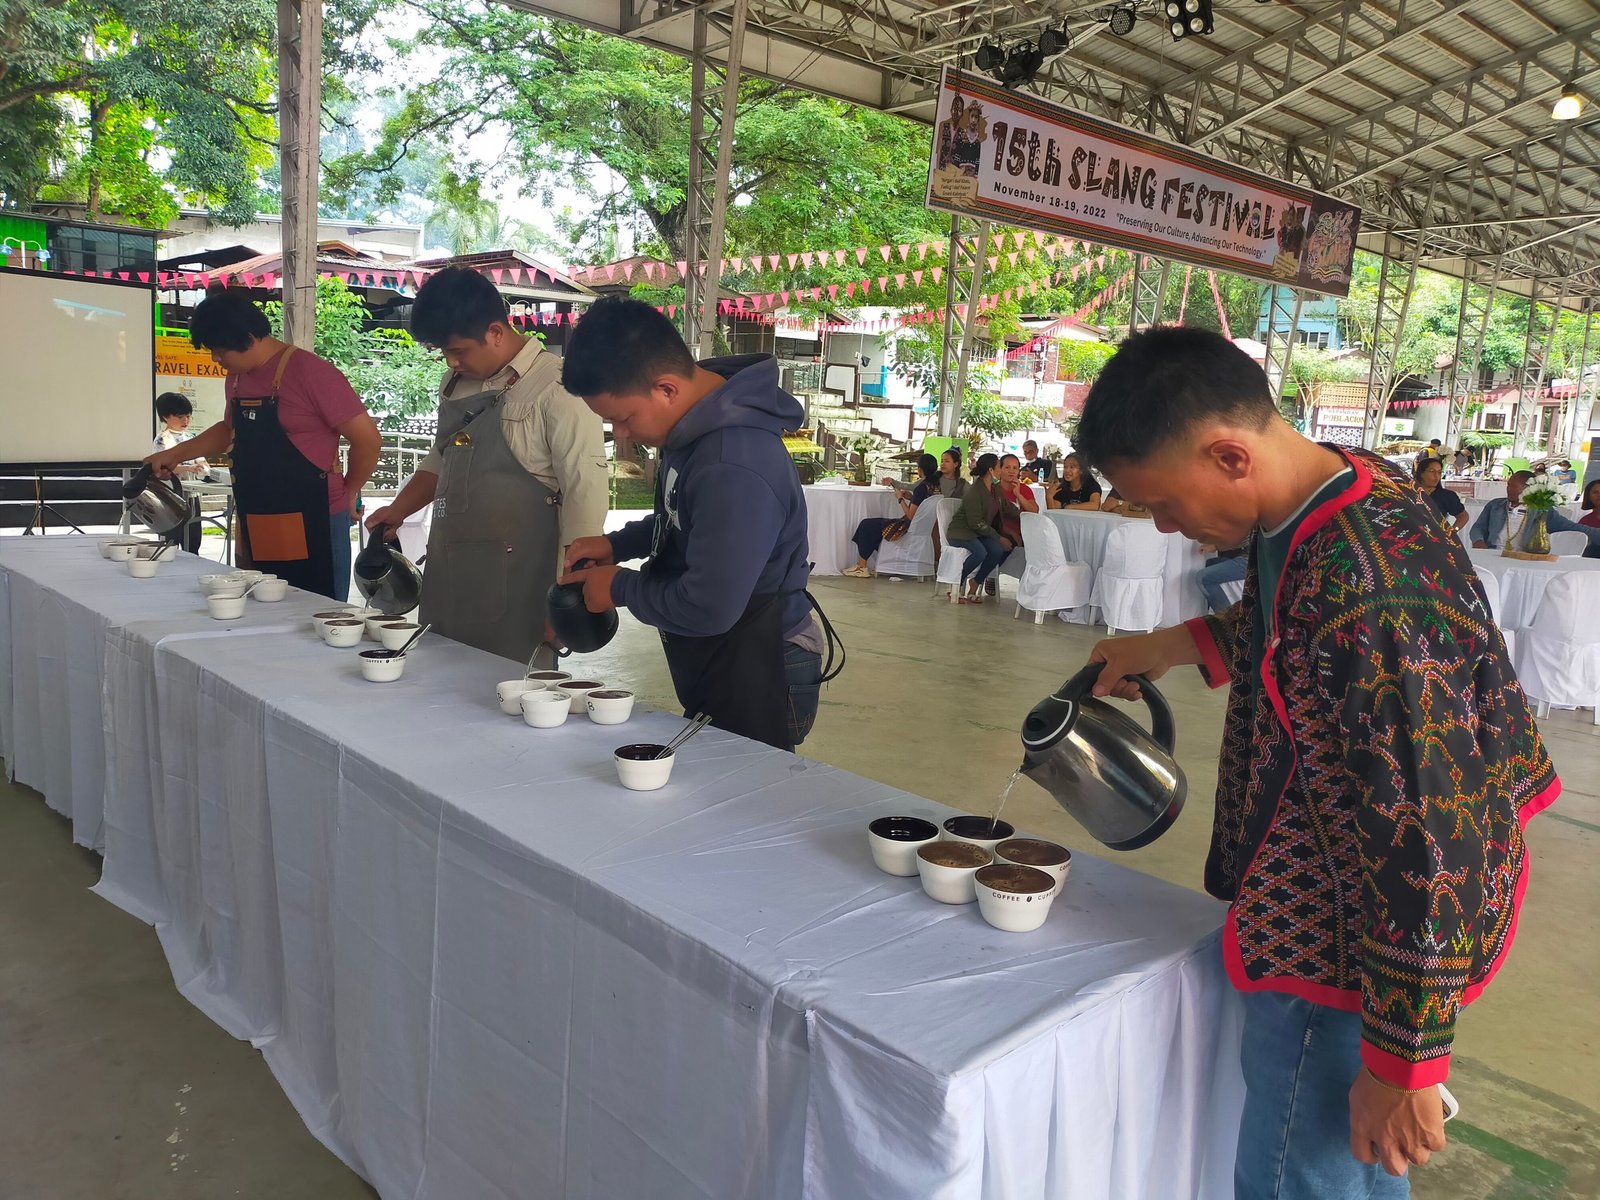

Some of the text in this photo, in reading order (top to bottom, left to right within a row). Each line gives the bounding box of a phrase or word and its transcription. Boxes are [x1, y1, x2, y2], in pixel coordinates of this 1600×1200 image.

[992, 121, 1276, 240] 15th SLANG FESTIVAL
[993, 181, 1106, 219] November 18-19, 2022
[1116, 212, 1153, 231] "Preserving
[1154, 222, 1166, 234] Our
[1167, 225, 1191, 242] Culture,
[1191, 231, 1222, 250] Advancing
[1221, 239, 1233, 251] Our
[992, 892, 1020, 901] COFFEE
